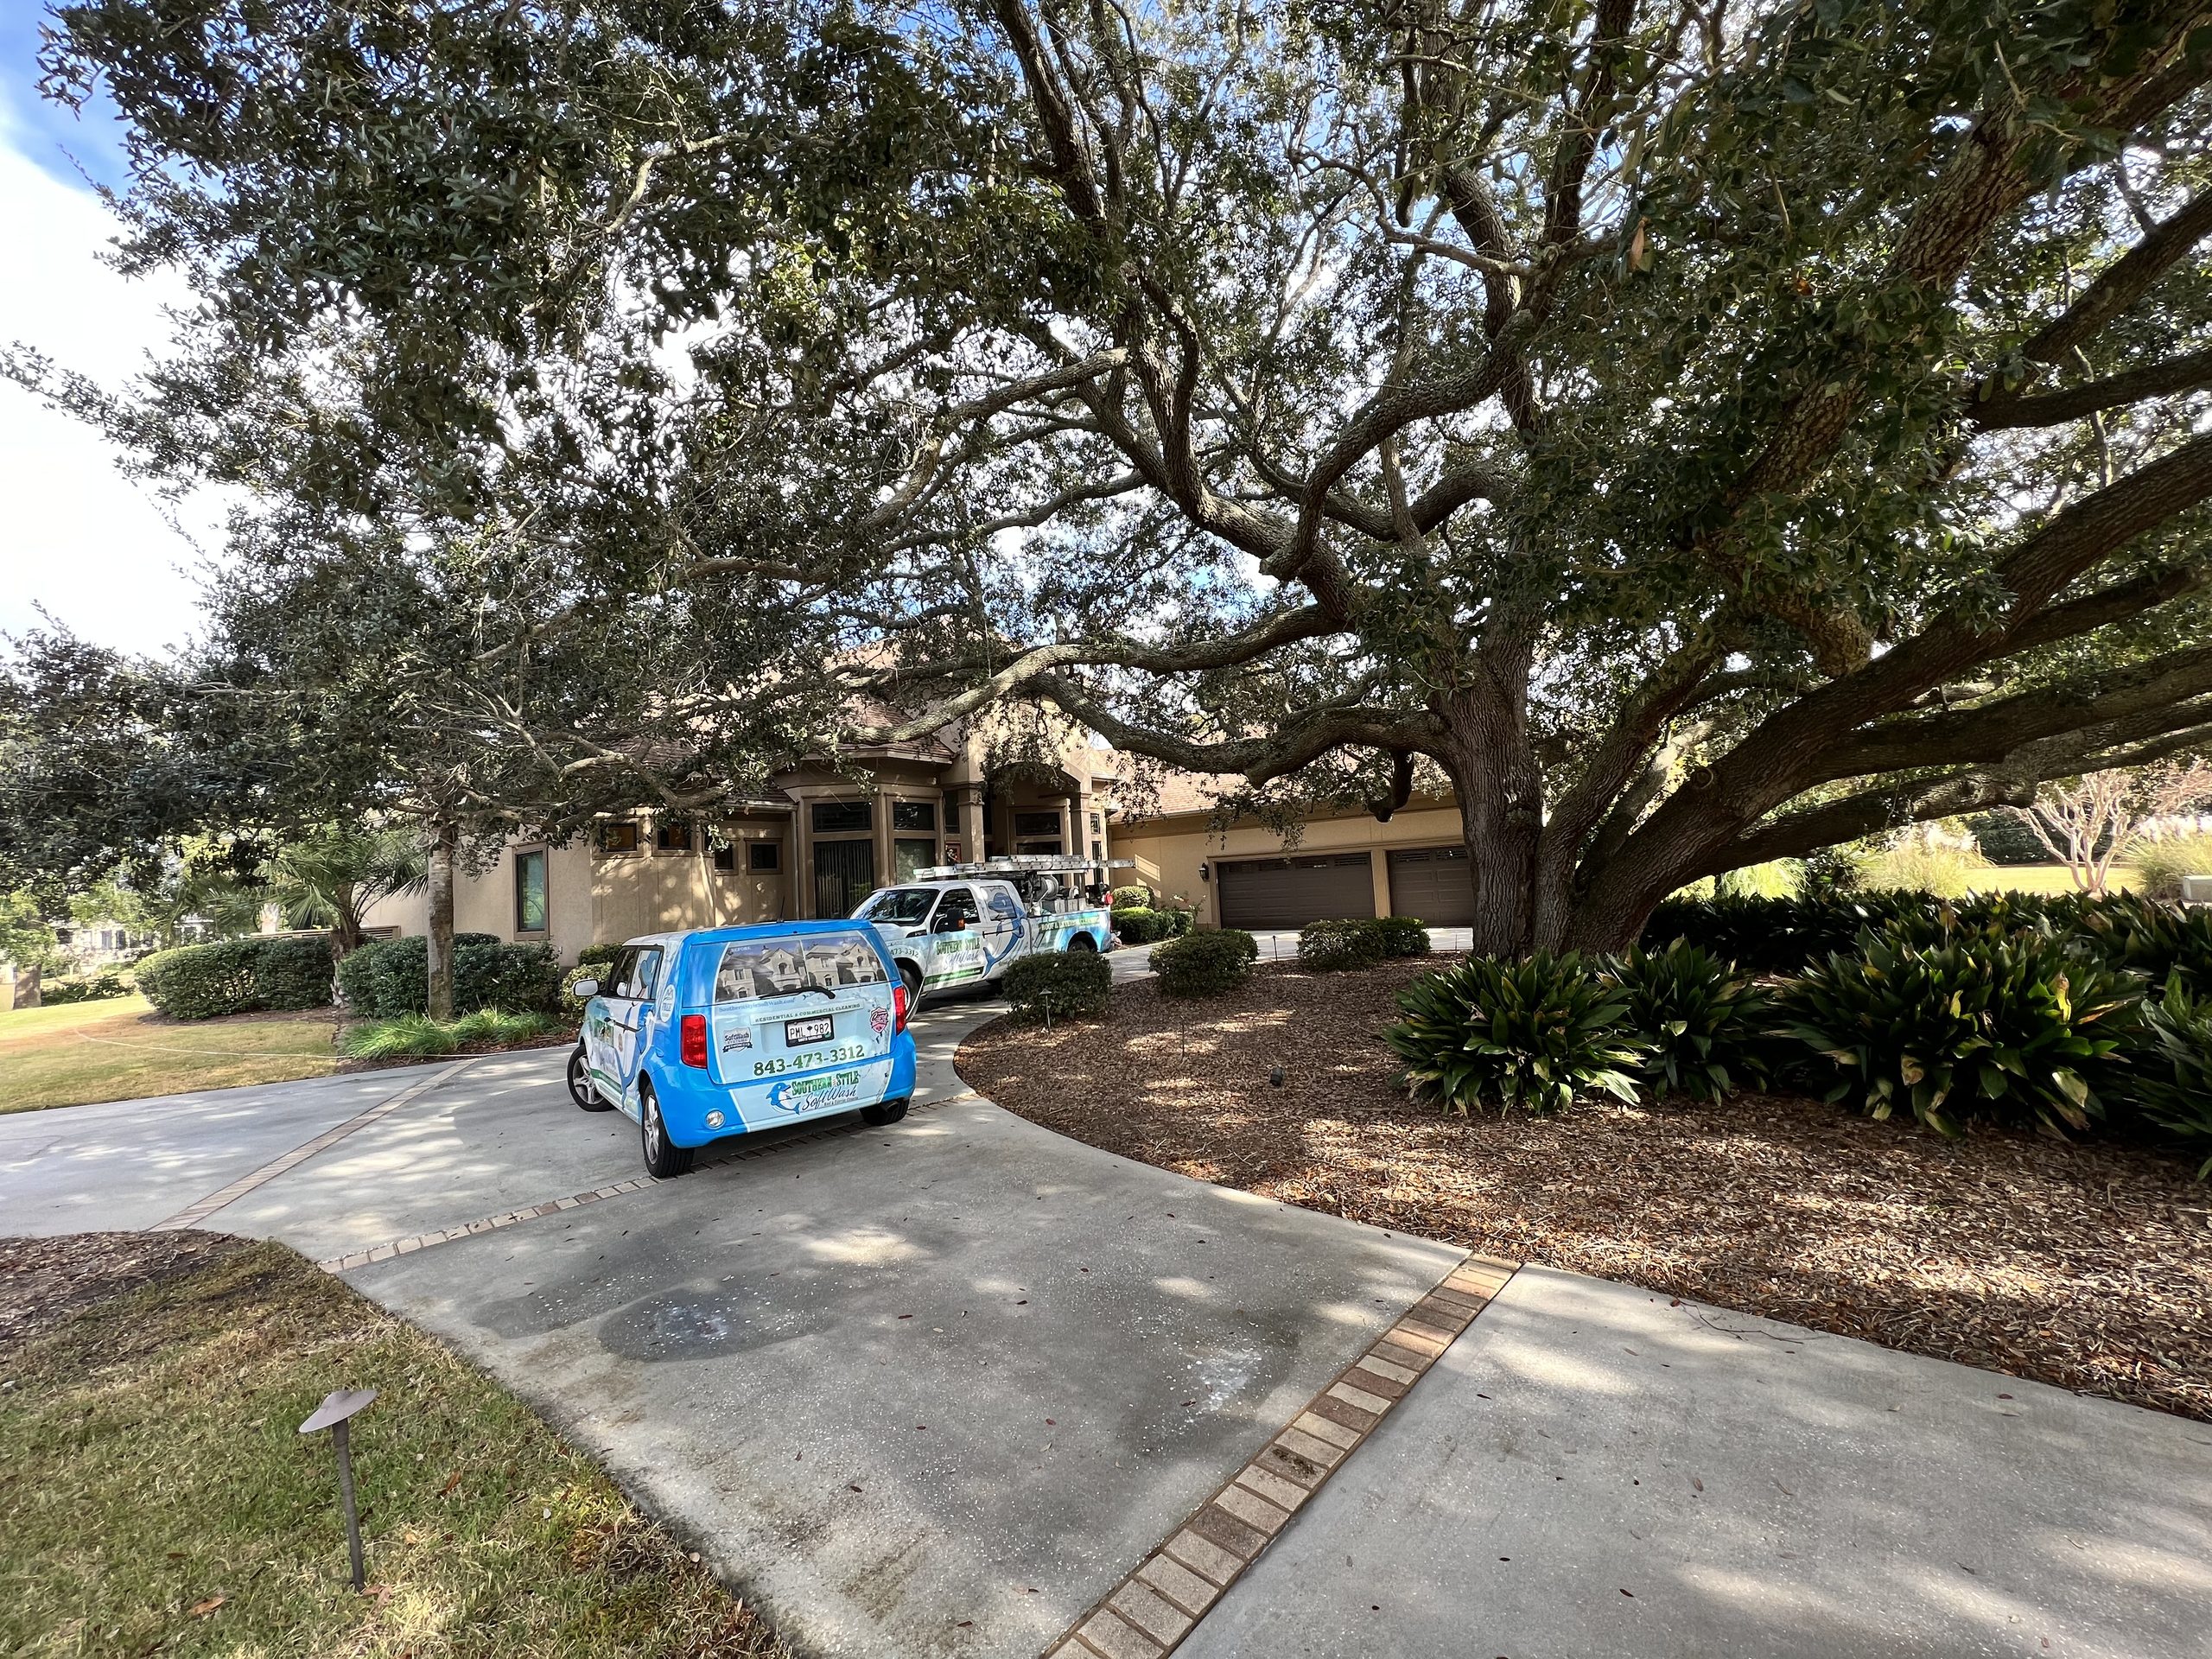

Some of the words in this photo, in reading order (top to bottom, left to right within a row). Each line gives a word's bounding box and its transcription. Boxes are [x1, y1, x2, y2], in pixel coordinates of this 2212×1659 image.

[889, 947, 918, 957] 473-3312
[755, 1013, 793, 1023] RESIDENTIAL
[798, 1007, 835, 1016] COMMERCIAL
[790, 1027, 806, 1039] PML
[753, 1045, 865, 1076] 843-473-3312
[791, 1076, 832, 1096] SOUTHERN
[836, 1071, 859, 1087] STYLE
